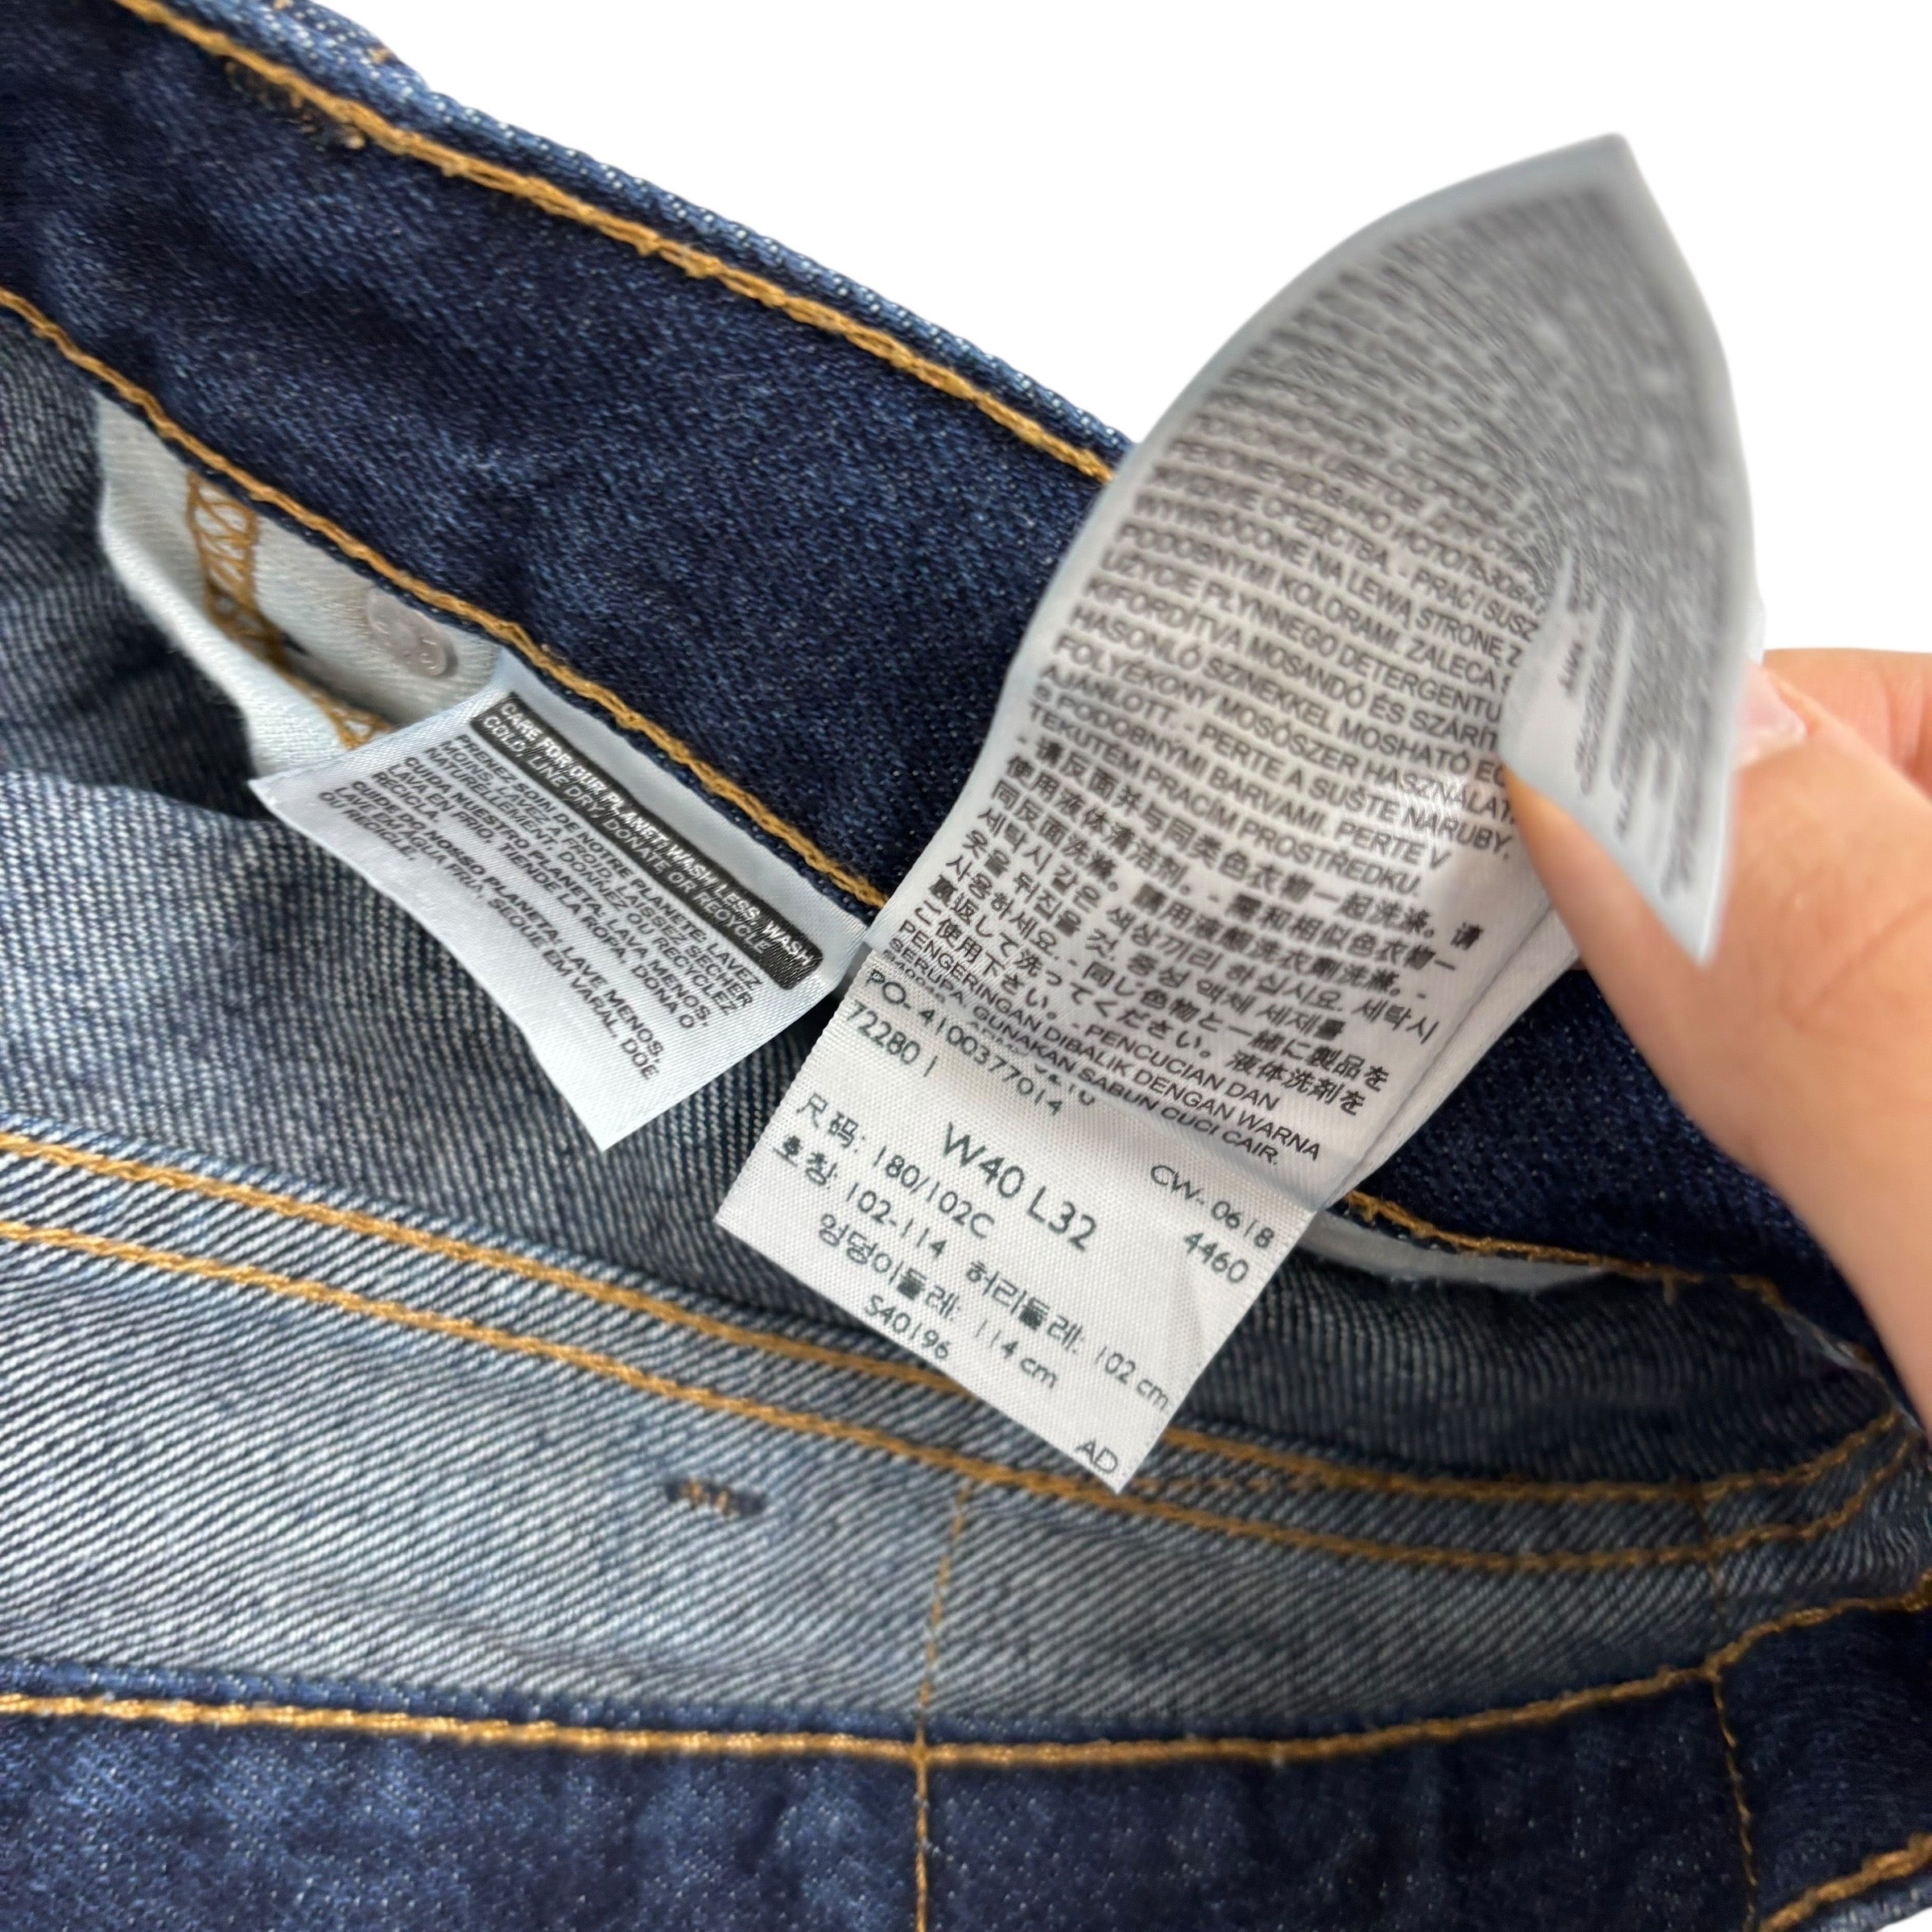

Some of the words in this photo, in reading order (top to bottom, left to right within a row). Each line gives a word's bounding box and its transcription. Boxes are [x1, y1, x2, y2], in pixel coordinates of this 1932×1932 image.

[1274, 574, 1402, 653] KOLORAMI.
[1404, 637, 1500, 691] ZALECA
[1307, 548, 1348, 585] NA
[1345, 569, 1415, 629] LEWĄ
[1413, 604, 1507, 667] STRONĘ
[1030, 702, 1142, 775] TEKUTÉM
[1336, 718, 1472, 778] MOSHATÓ
[1338, 643, 1504, 725] DETERGENTU
[1368, 691, 1408, 726] ÉS
[317, 790, 346, 810] OU
[1196, 722, 1286, 782] PERTE
[1282, 766, 1307, 792] A
[350, 779, 400, 814] CUIDE
[397, 811, 427, 832] DO
[423, 830, 487, 876] NOSSO
[561, 946, 609, 989] LAVE
[388, 763, 427, 795] LAVA
[426, 791, 454, 811] EN
[498, 843, 560, 893] TIENDE
[556, 892, 580, 916] LA
[631, 963, 678, 1014] DONA
[676, 1011, 696, 1030] O
[404, 756, 452, 794] CUIDA
[450, 791, 530, 850] NUESTRO
[606, 918, 649, 959] LAVA
[456, 733, 517, 783] PRENEZ
[514, 782, 556, 812] SOIN
[552, 811, 580, 832] DE
[576, 831, 634, 877] NOTRE
[707, 943, 762, 990] LAVEZ
[497, 786, 549, 824] LAVEZ
[615, 884, 686, 945] LAISSEZ
[499, 700, 542, 741] CARE
[535, 736, 572, 768] FOR
[569, 764, 608, 796] OUR
[668, 844, 718, 886] WASH
[762, 922, 814, 966] WASH
[529, 755, 569, 788] LINE
[602, 817, 671, 873] DONATE
[667, 870, 696, 894] OR
[693, 890, 771, 954] RECYCLE
[976, 807, 1054, 874] 세탁시
[1334, 820, 1426, 866] PERTE
[1432, 846, 1451, 869] V
[334, 785, 375, 814] LAVE
[371, 811, 402, 831] EM
[541, 948, 572, 976] EM
[621, 1037, 658, 1080] DOE
[558, 849, 629, 912] DONNEZ
[626, 911, 654, 935] OU
[653, 936, 737, 1015] RECYCLEZ
[898, 919, 1042, 1034] PENGERINGAN
[1043, 1024, 1133, 1077] DIBALIK
[1133, 1067, 1235, 1121] DENGAN
[1237, 1108, 1320, 1161] WARNA
[972, 1003, 1076, 1073] GUNAKAN
[1077, 1067, 1158, 1112] SABUN
[1160, 1104, 1219, 1136] CUCI
[1220, 1126, 1280, 1166] CAIR.
[1084, 1022, 1224, 1091] PENCUCIAN
[1226, 1083, 1278, 1111] DAN
[863, 968, 919, 1015] PO-
[914, 1003, 1066, 1119] 4100377014
[1207, 1197, 1278, 1252] 0618
[870, 1144, 997, 1241] 180/102C
[931, 1120, 1030, 1202] W40
[1024, 1183, 1103, 1253] L32
[844, 1181, 949, 1259] 102-114
[1093, 1344, 1140, 1386] 102
[1133, 1376, 1173, 1412] cm
[1178, 1226, 1252, 1286] 4460
[862, 1292, 956, 1362] S40196
[1073, 1437, 1121, 1477] AD
[972, 1319, 1021, 1361] 114
[1018, 1353, 1061, 1390] cm
